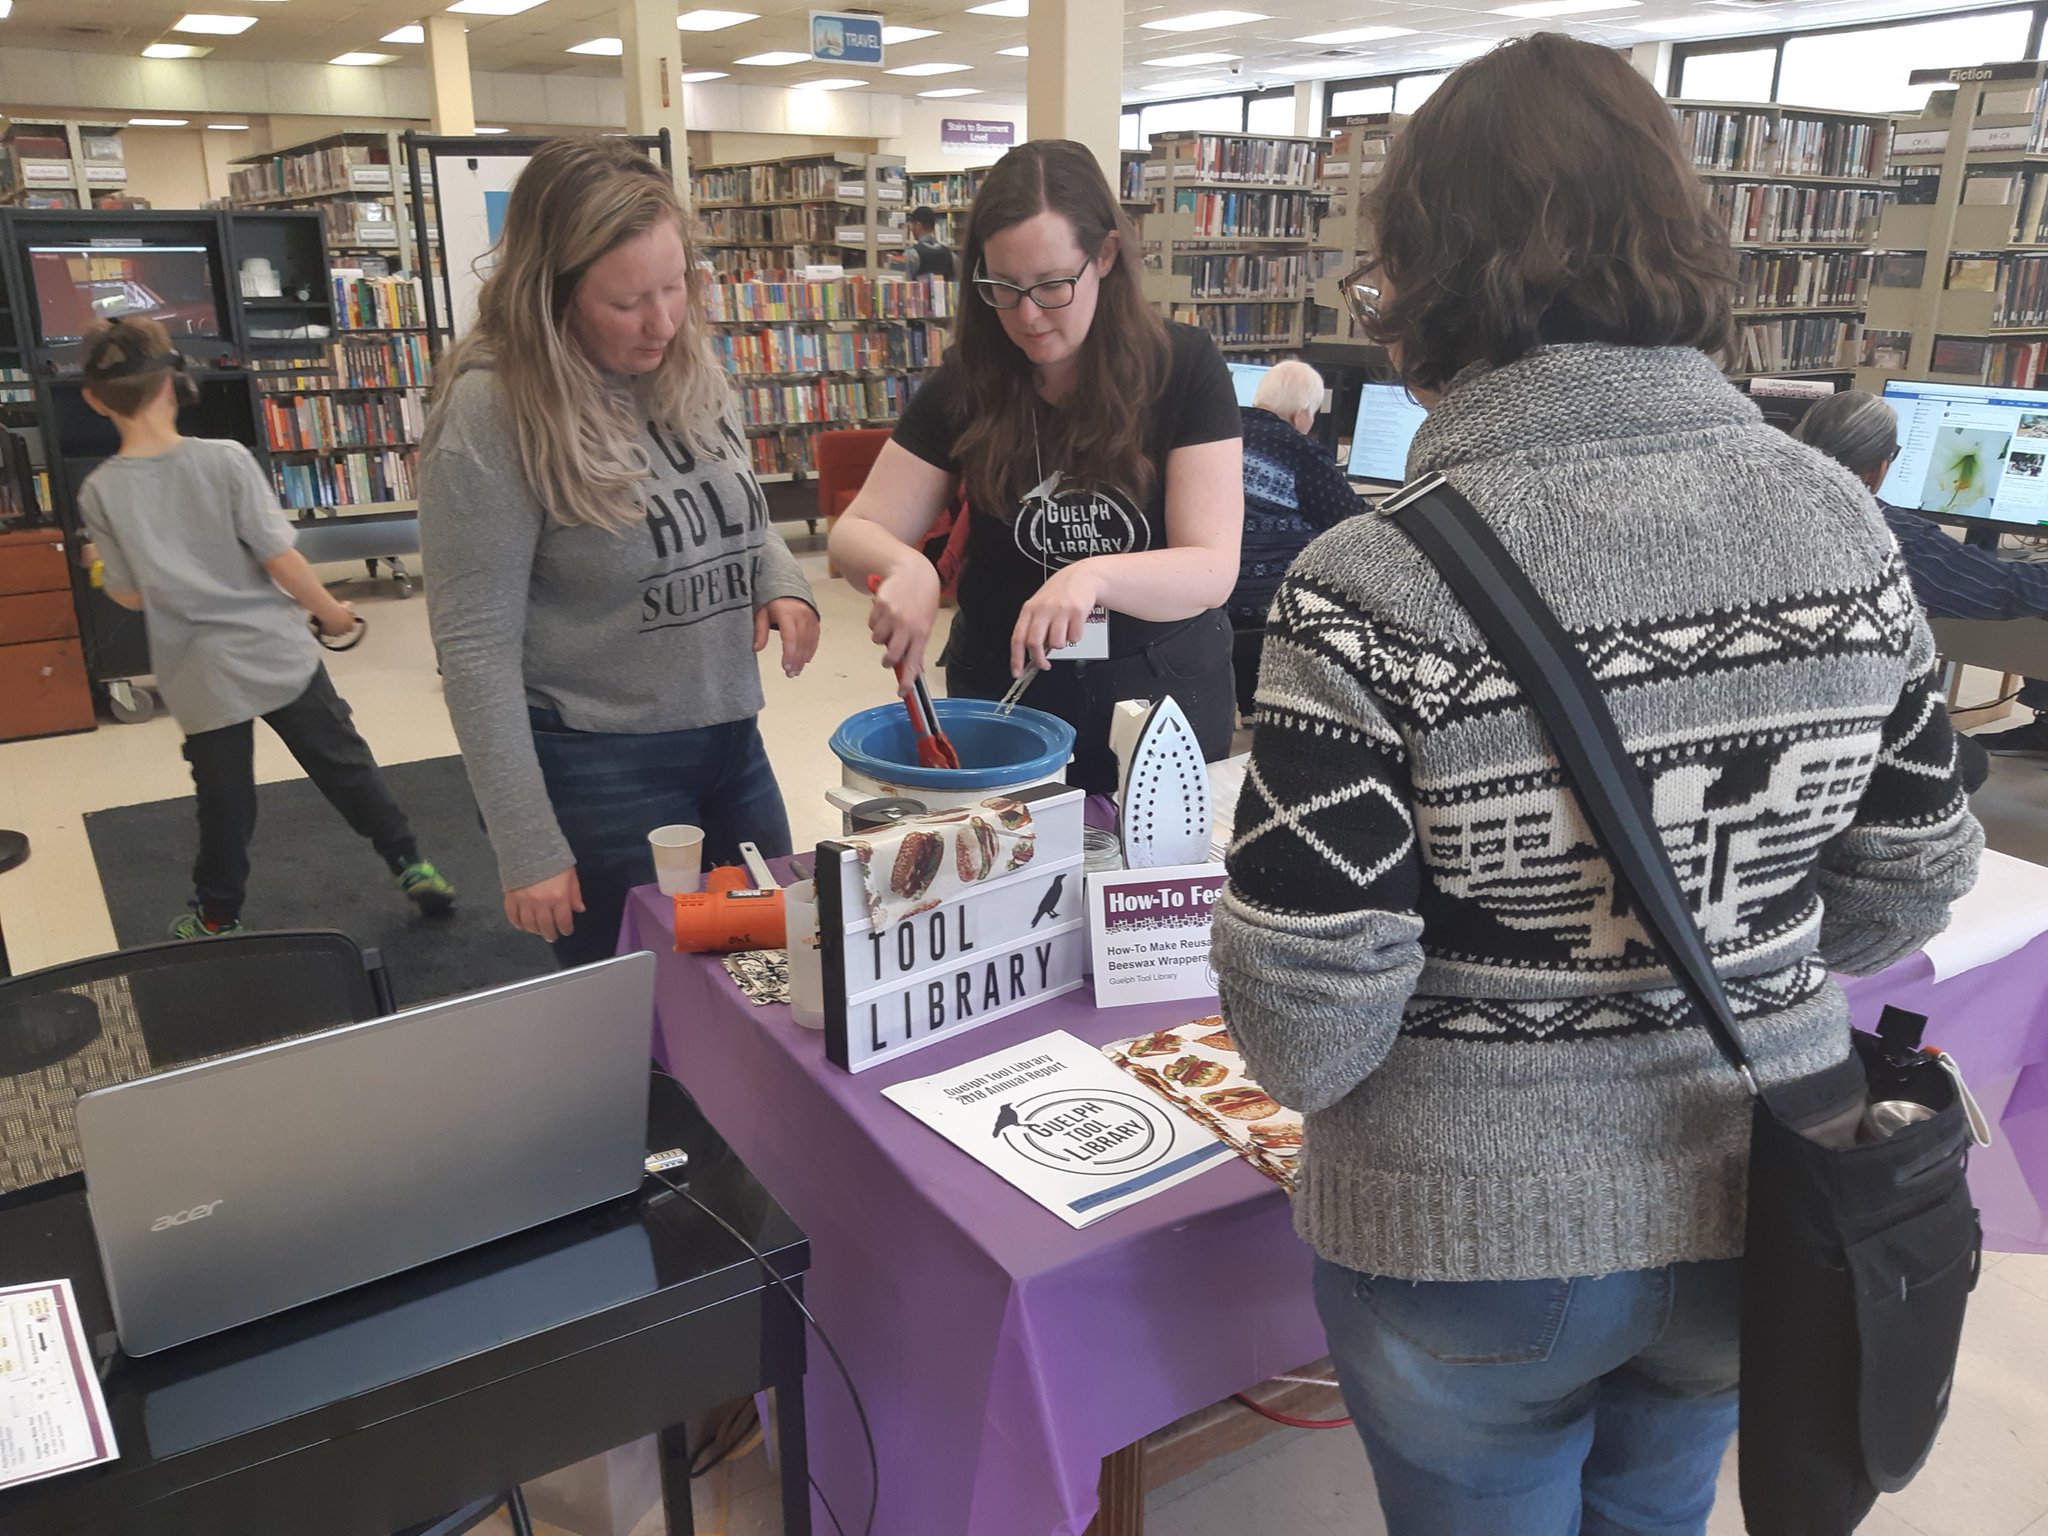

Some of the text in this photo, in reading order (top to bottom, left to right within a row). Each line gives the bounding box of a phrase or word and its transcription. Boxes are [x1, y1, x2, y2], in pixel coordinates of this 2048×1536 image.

[845, 32, 880, 49] TRAVEL
[1948, 69, 1993, 81] Fiction
[947, 122, 1009, 134] Stairs to Basement
[1345, 117, 1369, 125] Fiction
[970, 132, 988, 142] Level
[1047, 503, 1111, 523] GUELPH
[1062, 524, 1102, 540] TOOL
[1046, 537, 1122, 555] LIBRARY
[1109, 888, 1184, 913] How-To
[868, 905, 973, 980] TOOL
[1107, 944, 1147, 956] How-To
[1150, 941, 1178, 952] Make
[1108, 954, 1208, 971] Beeswax Wrappers
[1109, 972, 1178, 985] Guelph Tool Library
[871, 942, 1052, 1051] LIBRARY
[943, 1053, 1054, 1096] Guelph Tool Library
[955, 1061, 1068, 1105] 2018 Annual Report
[1028, 1102, 1104, 1138] GUELPH
[1062, 1119, 1112, 1142] TOOL
[1062, 1119, 1146, 1161] LIBRARY
[150, 1199, 224, 1231] acer
